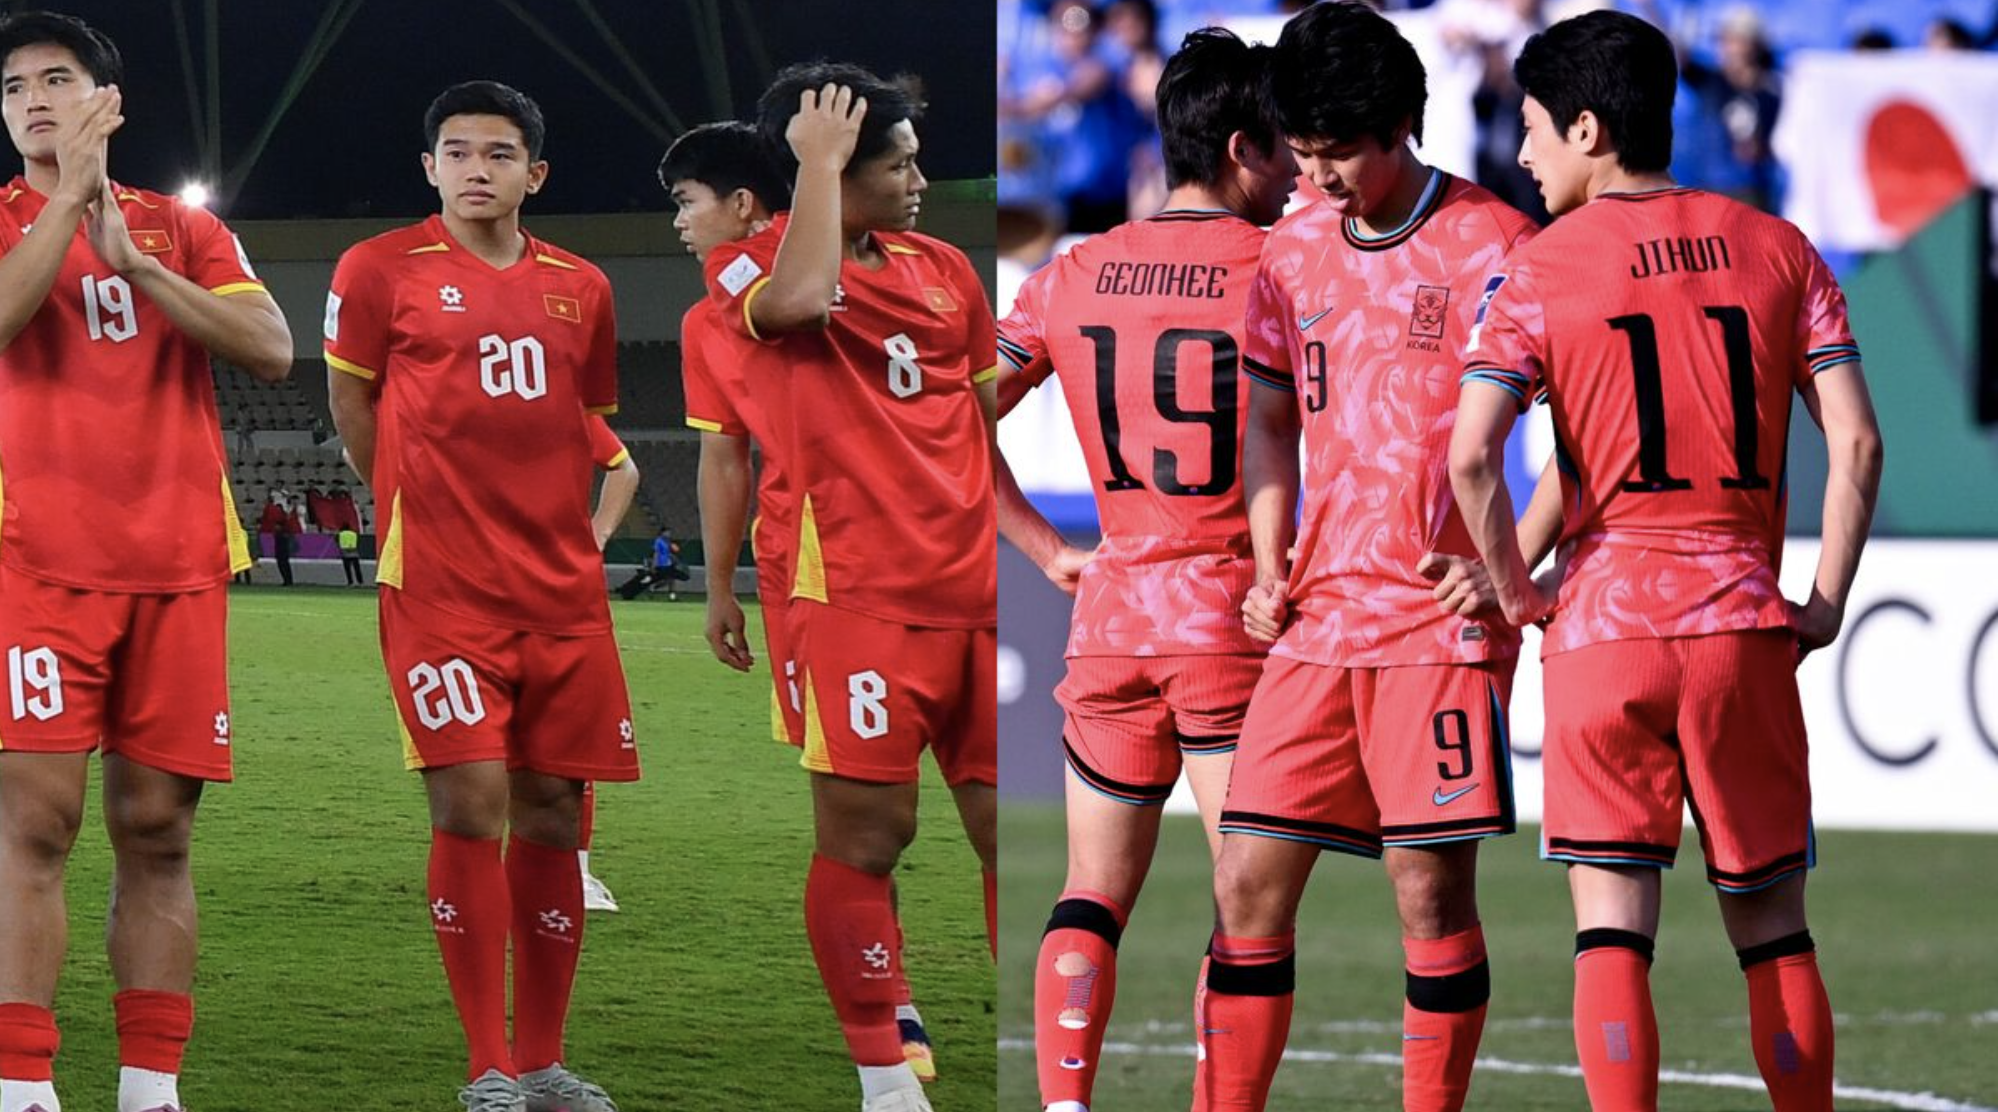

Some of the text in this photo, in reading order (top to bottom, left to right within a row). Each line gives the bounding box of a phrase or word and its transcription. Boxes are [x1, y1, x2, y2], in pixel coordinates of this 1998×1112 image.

[1095, 261, 1228, 299] GEONHEE
[1630, 235, 1732, 278] JIHUN
[80, 273, 139, 343] 19
[479, 334, 547, 401] 20
[883, 333, 923, 398] 8
[1305, 340, 1328, 413] 9
[1406, 340, 1441, 353] KOREA
[1079, 325, 1239, 497] 19
[1604, 305, 1771, 492] 11
[7, 645, 64, 721] 19
[407, 658, 486, 731] 20
[847, 670, 889, 739] 8
[1433, 708, 1473, 781] 9
